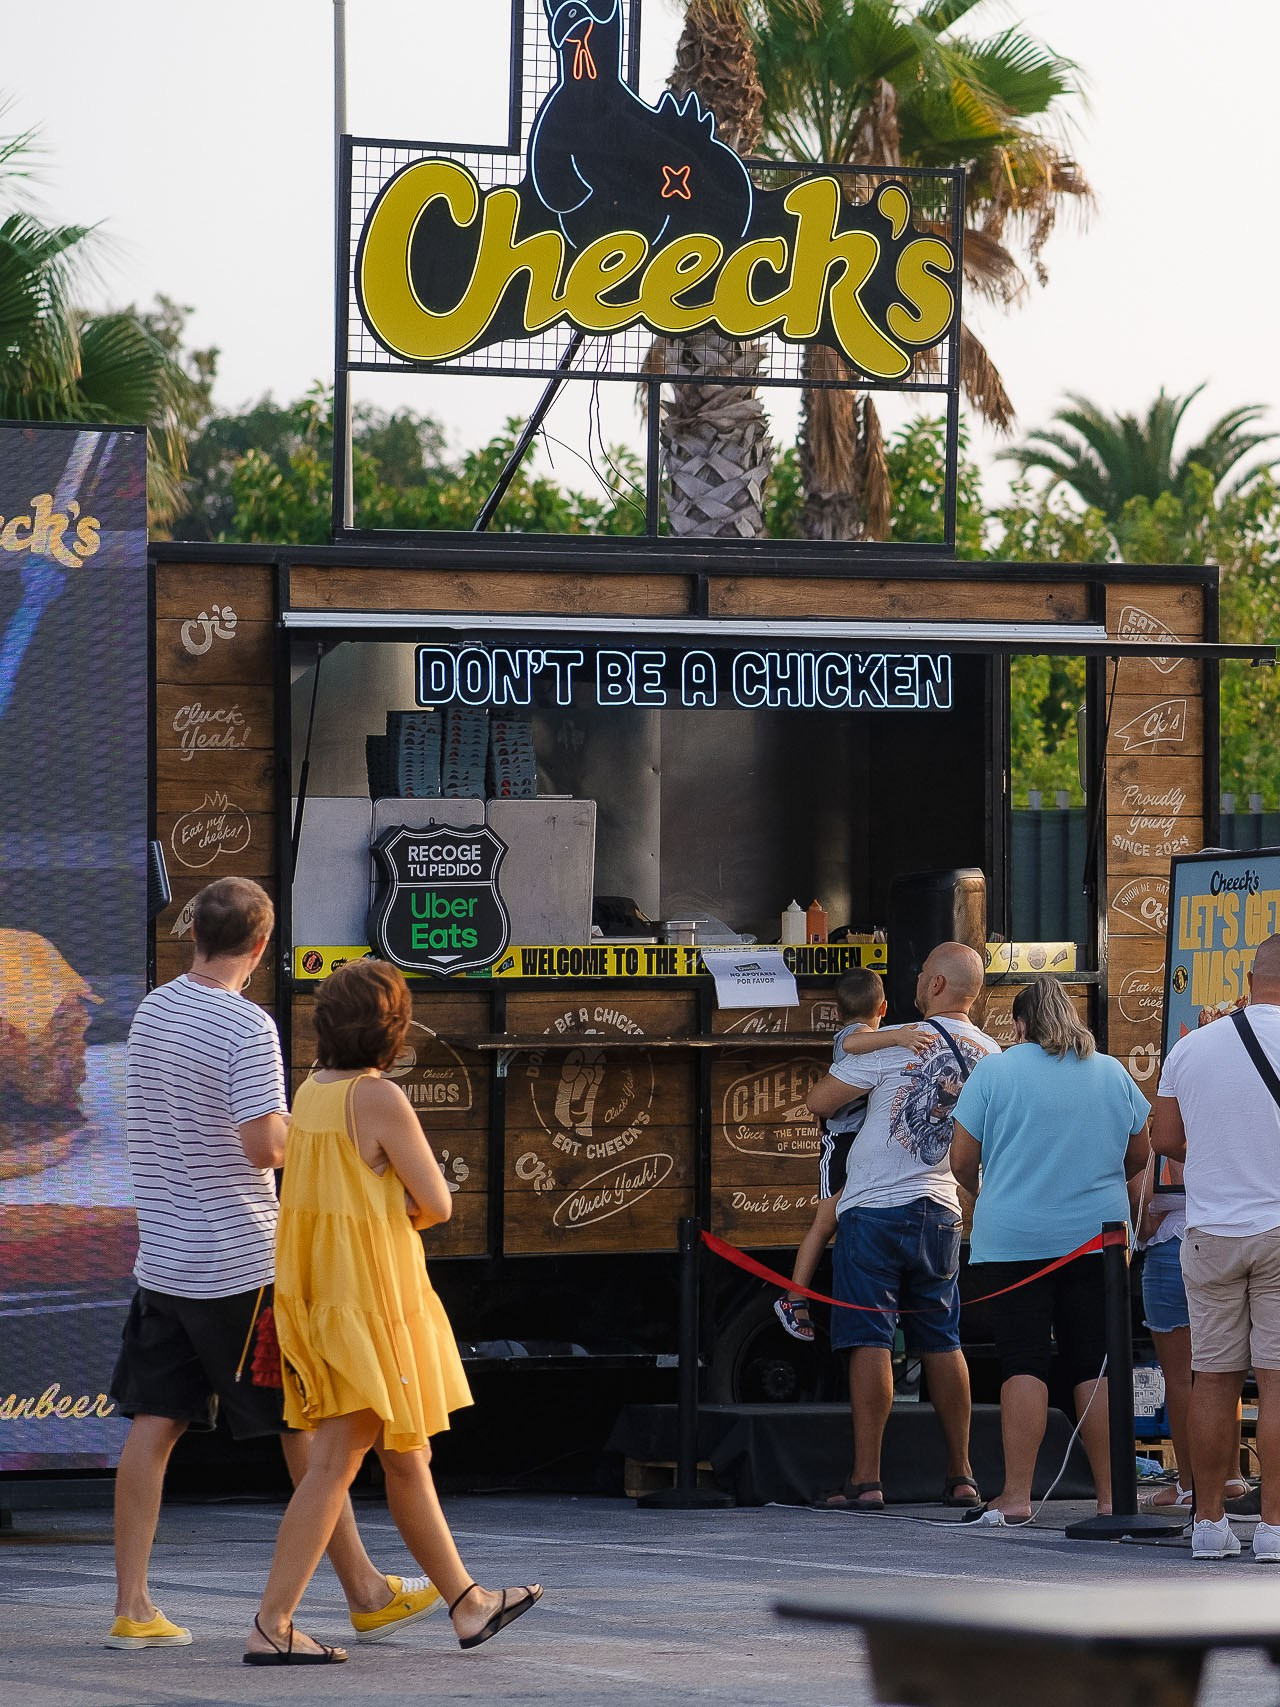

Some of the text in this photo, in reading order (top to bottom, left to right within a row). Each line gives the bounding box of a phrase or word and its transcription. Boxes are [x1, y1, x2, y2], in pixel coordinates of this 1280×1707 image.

[360, 156, 954, 380] Cheeck's
[0, 493, 101, 568] ck's
[1128, 610, 1158, 633] EAT
[419, 647, 953, 709] DON'T BE A CHICKEN
[173, 702, 246, 732] Cluck
[1143, 707, 1181, 737] Ck's
[180, 726, 252, 762] Yeah!
[1121, 785, 1187, 813] Proudly
[181, 815, 227, 845] Eat my
[1126, 810, 1177, 836] Young
[199, 825, 244, 848] cheeks!
[1111, 834, 1191, 856] SINCE 2024
[407, 844, 482, 863] RECOGE
[407, 864, 482, 878] TU PEDIDO
[411, 892, 478, 919] Uber
[1121, 886, 1140, 906] SHOW
[1140, 882, 1151, 892] ME
[1178, 891, 1240, 951] LET'S
[411, 923, 478, 949] Eats
[521, 948, 608, 976] WELCOME
[613, 948, 640, 975] TO
[644, 947, 678, 975] THE
[783, 946, 862, 975] CHICKEN
[1128, 979, 1150, 994] Eat
[1191, 949, 1258, 1006] NAST
[554, 1012, 576, 1033] BE
[579, 1007, 589, 1022] A
[552, 1111, 651, 1159] EAT CHEECK'S
[735, 1125, 766, 1141] Since
[773, 1128, 792, 1139] THE
[777, 1141, 790, 1152] OF
[568, 1157, 658, 1222] Cluck Yeah!
[731, 1191, 770, 1213] Don't
[772, 1194, 792, 1212] be
[795, 1196, 807, 1209] a
